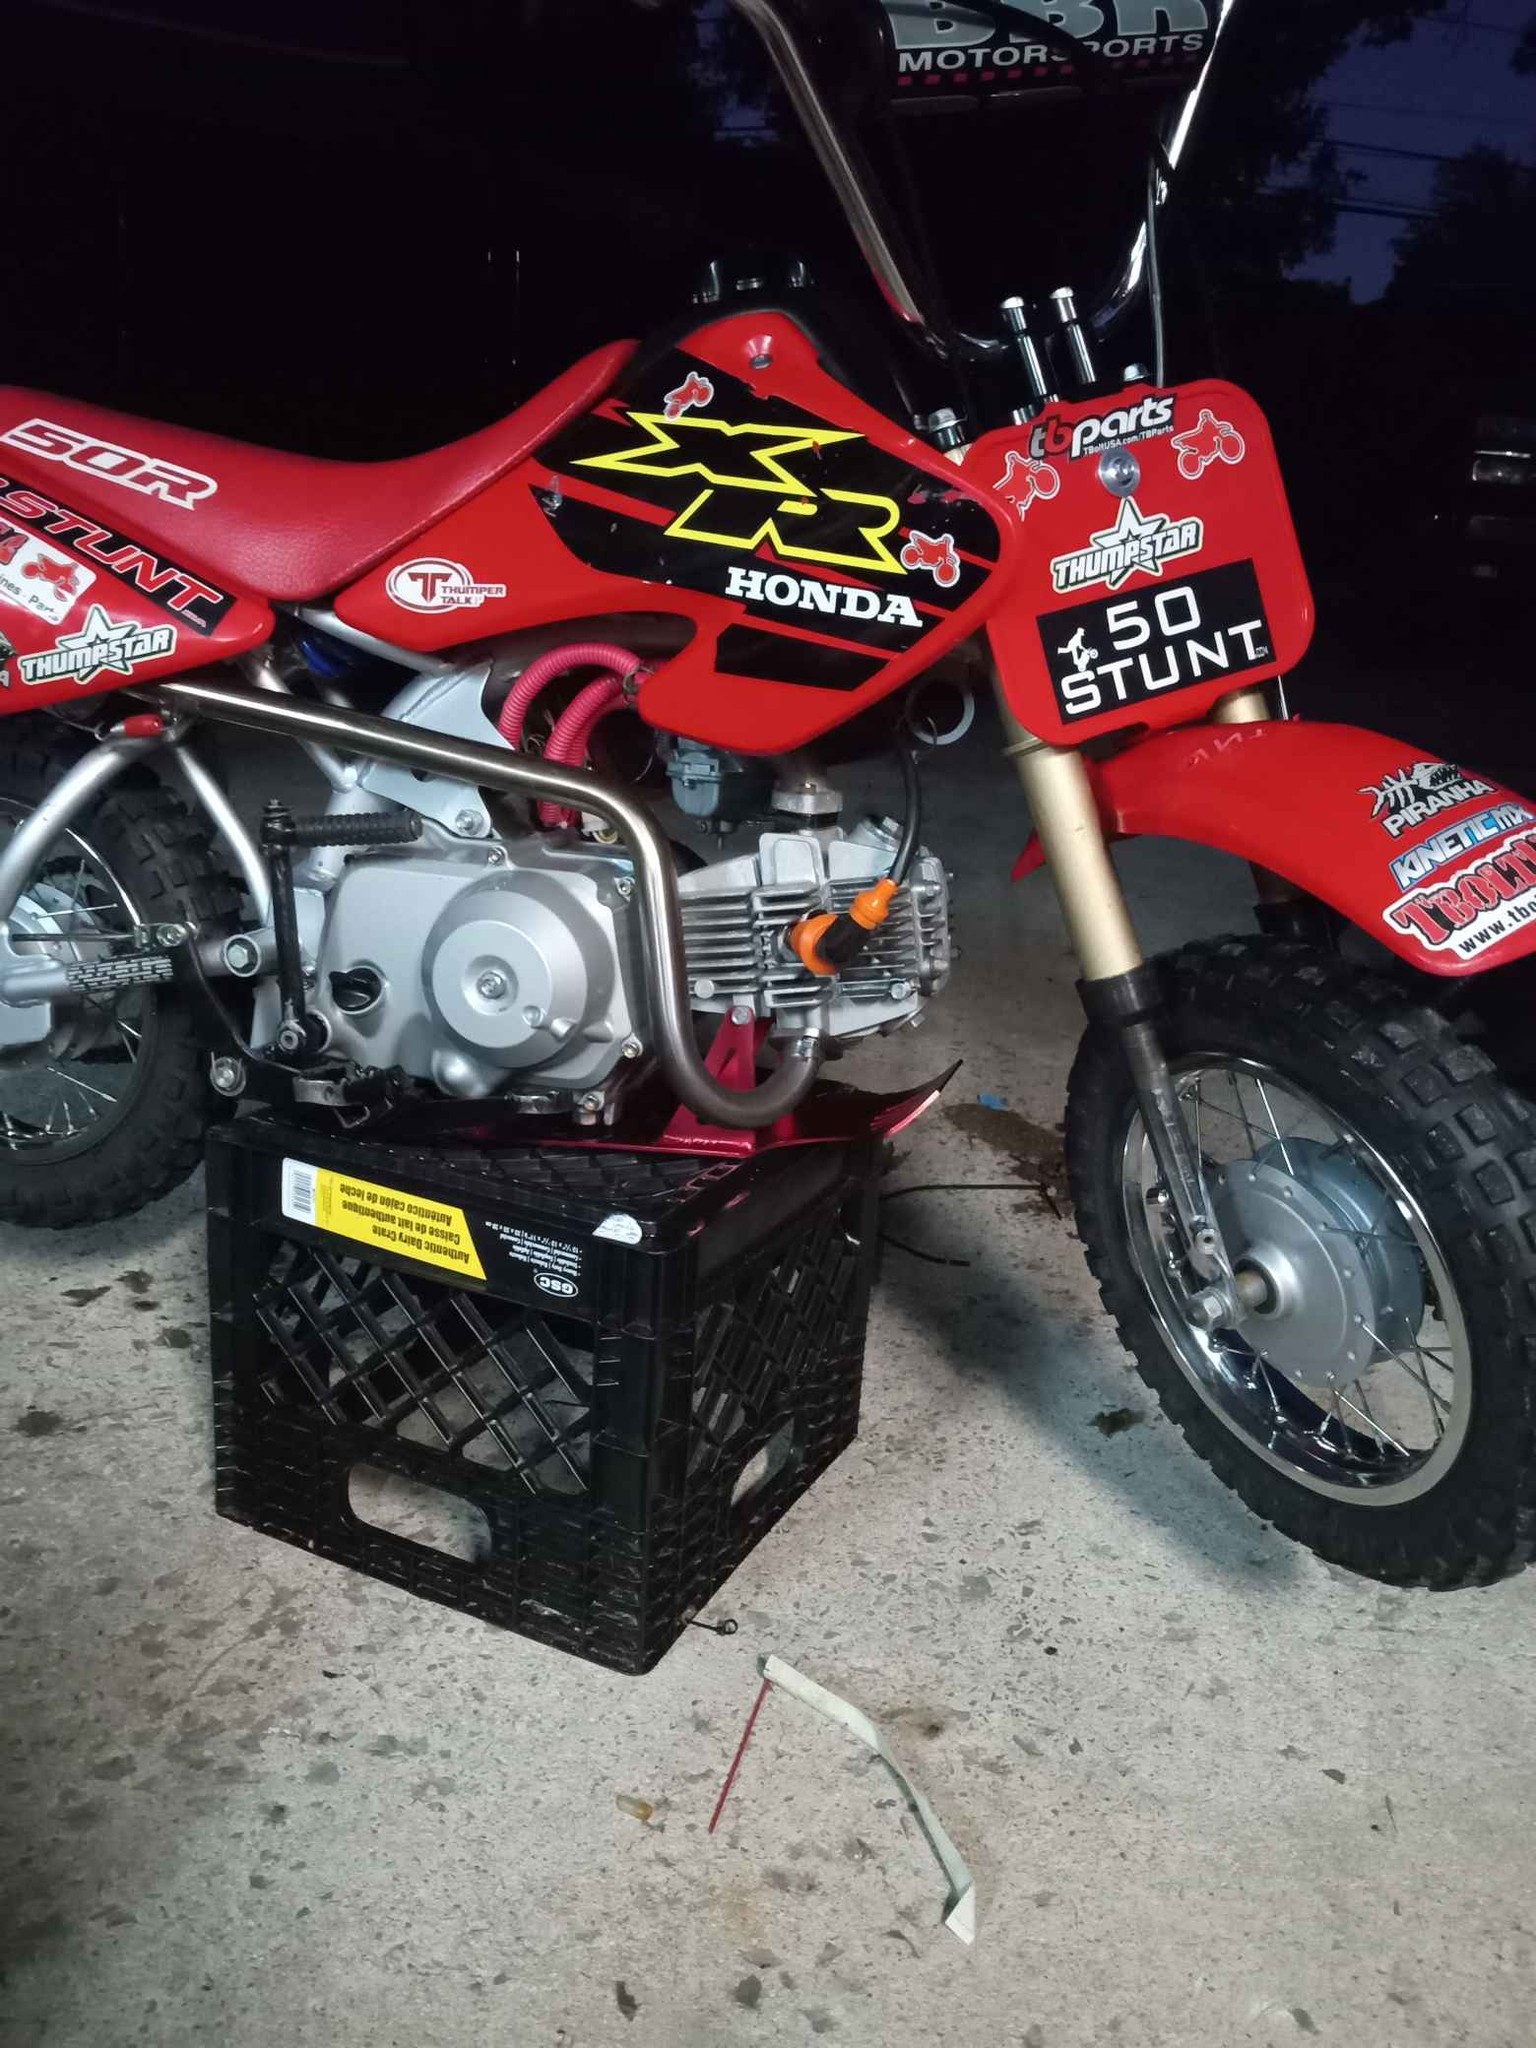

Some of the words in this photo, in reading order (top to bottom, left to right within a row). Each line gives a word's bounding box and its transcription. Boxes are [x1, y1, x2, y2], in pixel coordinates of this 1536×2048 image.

[899, 34, 1204, 72] MOTORORTS
[1, 418, 217, 511] 50R
[0, 490, 223, 611] STUNT
[1054, 520, 1200, 589] THUMPSTAR
[441, 586, 504, 595] THUMPER
[441, 596, 472, 605] TALK
[725, 567, 923, 627] HONDA
[1106, 586, 1201, 650] 50
[21, 628, 174, 682] THUMPSTAR
[1061, 619, 1262, 715] STUNT
[1382, 779, 1497, 838] PIRANHA
[1459, 894, 1536, 953] www.tbo
[339, 1184, 365, 1201] leche
[366, 1191, 378, 1206] de
[341, 1199, 396, 1226] authentique
[372, 1224, 397, 1242] Crate
[397, 1218, 414, 1234] lait
[414, 1222, 427, 1236] de
[428, 1227, 461, 1246] Caisse
[397, 1231, 423, 1250] Dairy
[423, 1240, 470, 1265] Authentic
[539, 1276, 574, 1295] GSC
